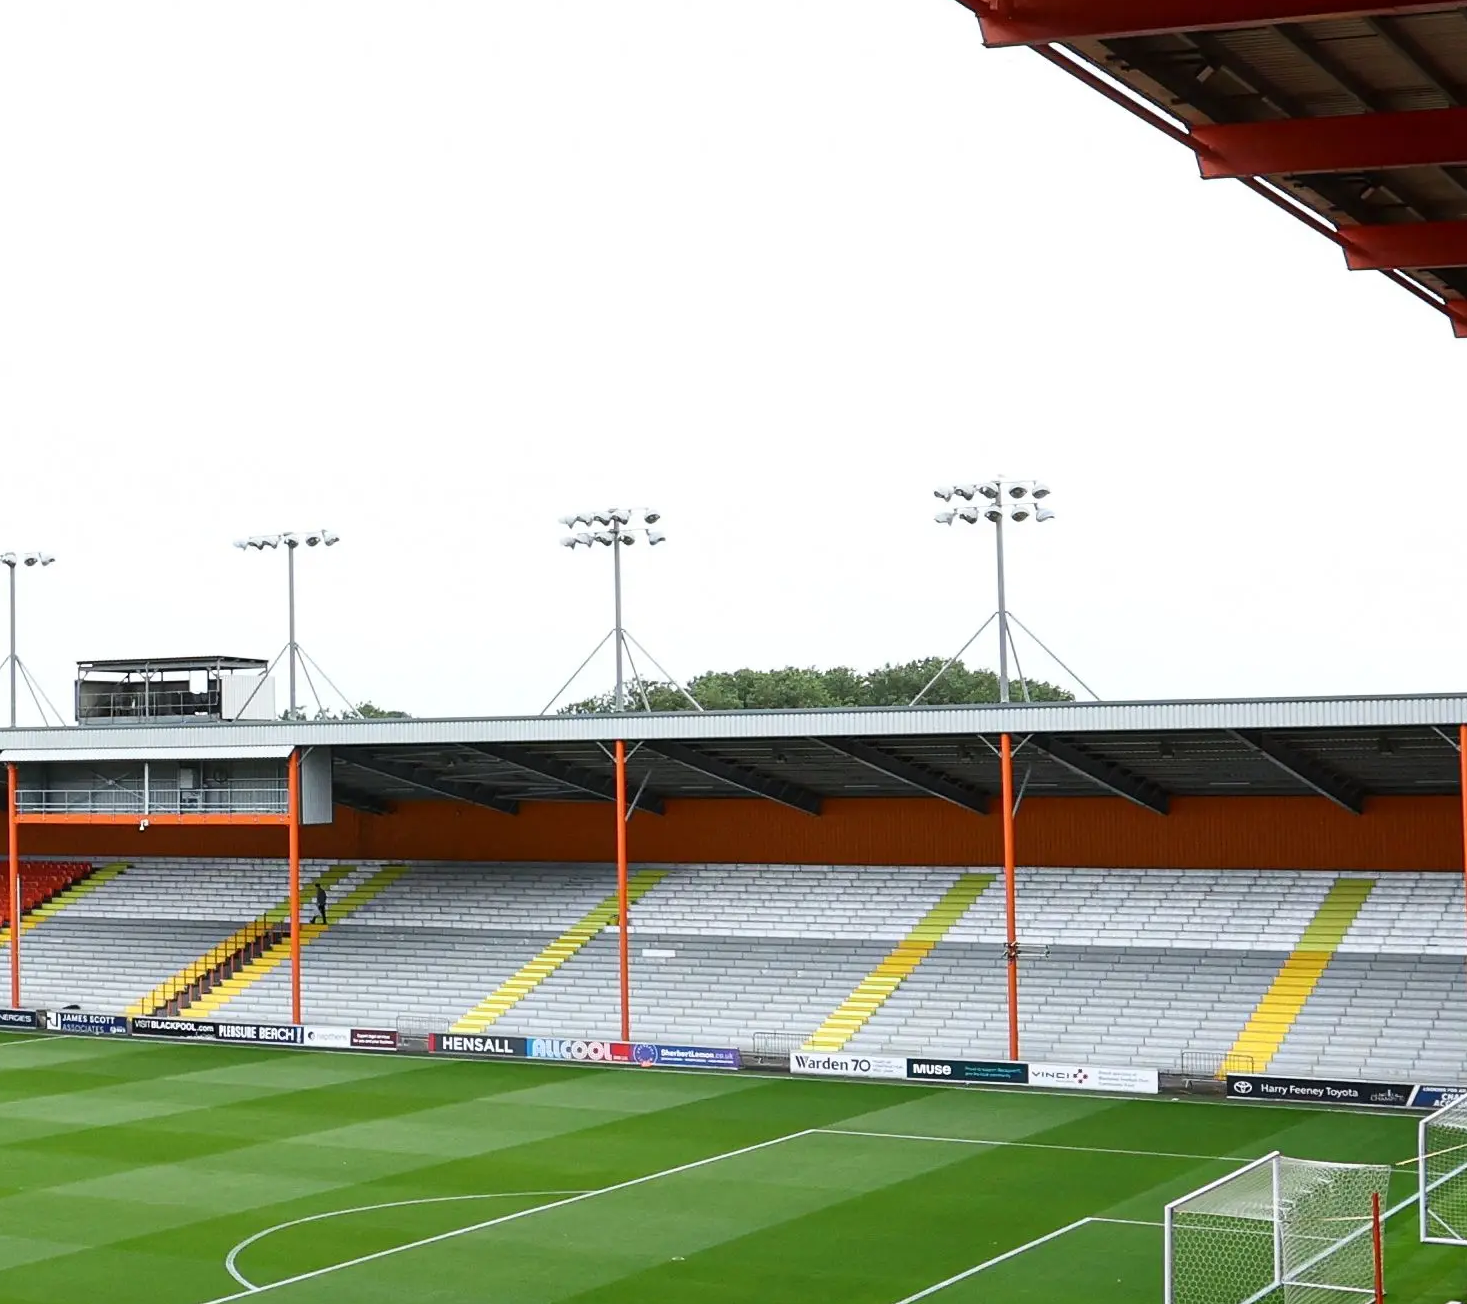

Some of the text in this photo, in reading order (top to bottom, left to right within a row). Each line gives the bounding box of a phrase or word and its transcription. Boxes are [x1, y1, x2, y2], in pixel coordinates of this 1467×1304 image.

[62, 1013, 115, 1024] JAMES SCOTT
[442, 1036, 514, 1054] HENSALL
[532, 1039, 612, 1061] ALLCOOL
[795, 1055, 848, 1071] Warden
[851, 1058, 871, 1072] 70
[1031, 1071, 1070, 1079] VINCI
[1261, 1083, 1288, 1096] Harry
[1290, 1085, 1324, 1097] Feeney
[1326, 1087, 1359, 1098] Toyota
